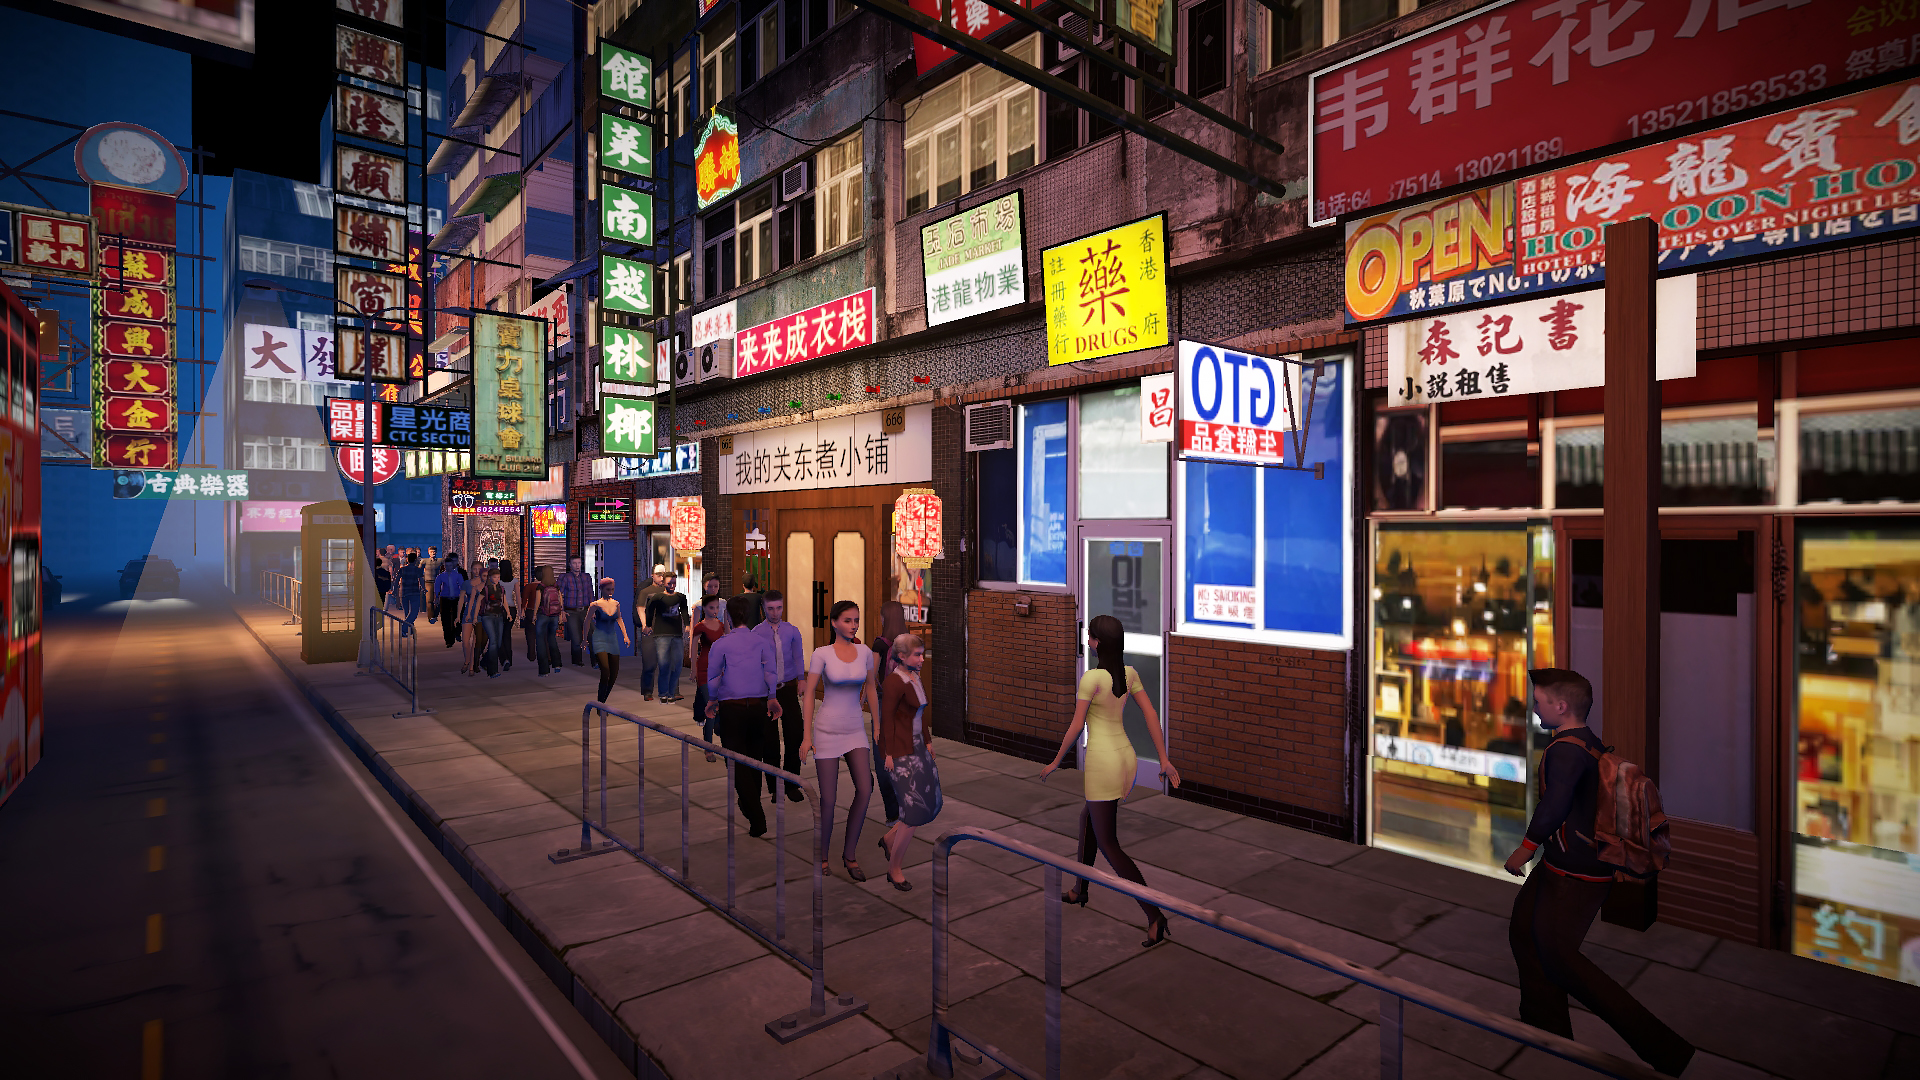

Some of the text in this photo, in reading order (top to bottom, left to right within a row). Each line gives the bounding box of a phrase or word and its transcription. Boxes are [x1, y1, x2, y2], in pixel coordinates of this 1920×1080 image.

[1627, 63, 1827, 138] 13521853533
[1455, 136, 1564, 184] 13021189
[1809, 158, 1920, 203] HO
[924, 196, 1016, 258] 玉石市場
[1523, 253, 1587, 275] HOTEL
[1713, 214, 1776, 238] OVER
[1783, 198, 1866, 224] NIGHT
[937, 238, 1004, 271] JADE MARKET
[931, 263, 1020, 314] 港龍物業
[1078, 238, 1131, 328] 藥
[737, 296, 867, 374] 来来成衣栈
[1075, 325, 1139, 355] DRUGS
[389, 430, 418, 443] CTC
[885, 411, 903, 427] 666
[499, 463, 521, 471] CLUB
[505, 454, 543, 463] BILLIARD
[735, 431, 890, 487] 我的关东煮小铺
